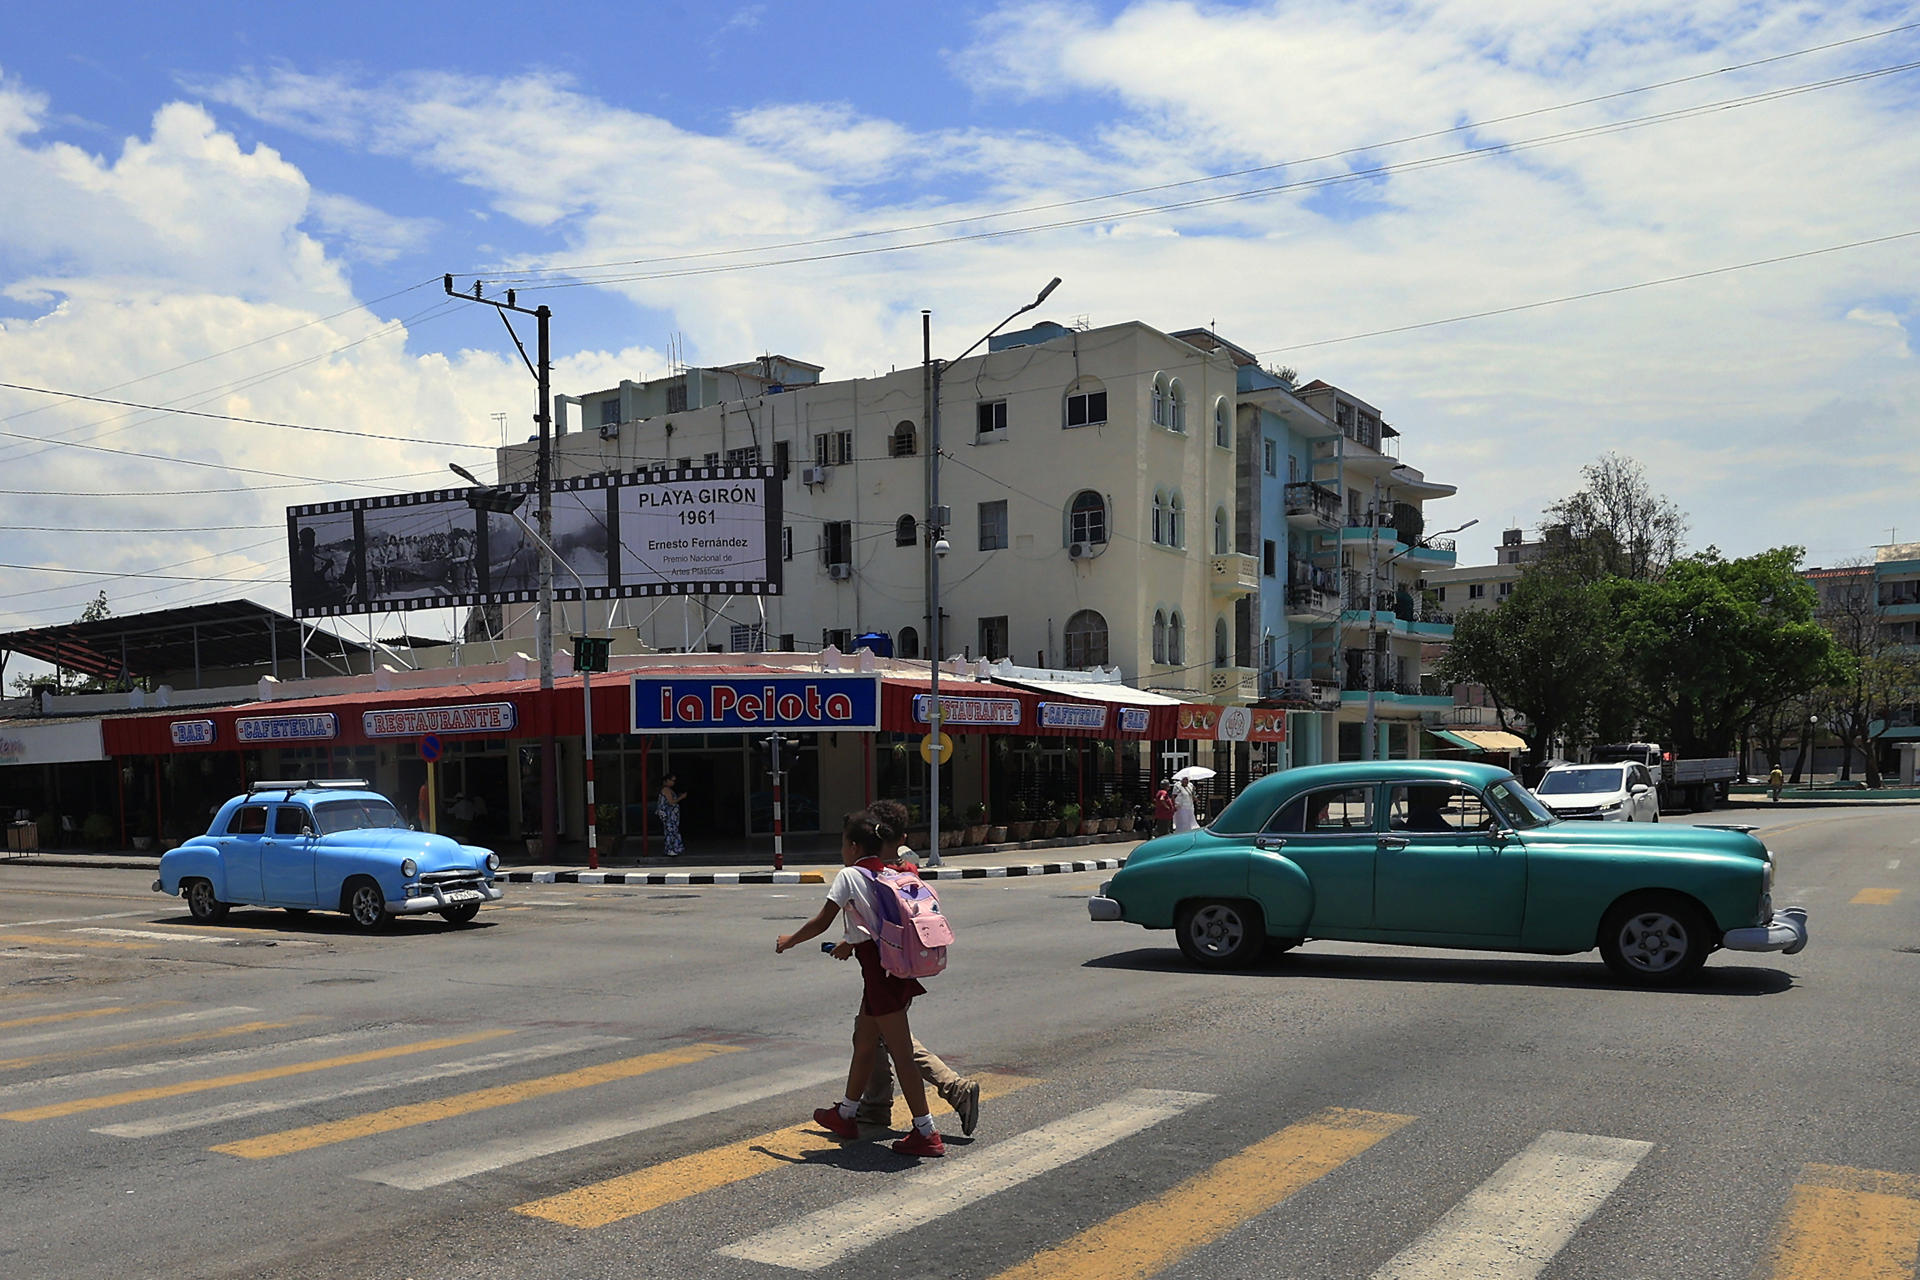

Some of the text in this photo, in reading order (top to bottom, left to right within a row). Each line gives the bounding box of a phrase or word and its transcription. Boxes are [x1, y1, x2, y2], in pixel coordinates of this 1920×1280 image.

[639, 484, 756, 508] PLAYA GIRÓN
[678, 509, 715, 525] 1961
[648, 537, 748, 550] Ernesto Fernández
[663, 554, 733, 563] Premio Nacional de
[671, 567, 725, 576] Artes Plásticas
[661, 685, 853, 722] la Pelota
[374, 708, 501, 733] RESTAURANTE
[1048, 706, 1101, 726] CAFETERIA
[1126, 711, 1144, 729] BAR
[178, 724, 205, 742] BAR
[243, 718, 327, 739] CAFETERIA
